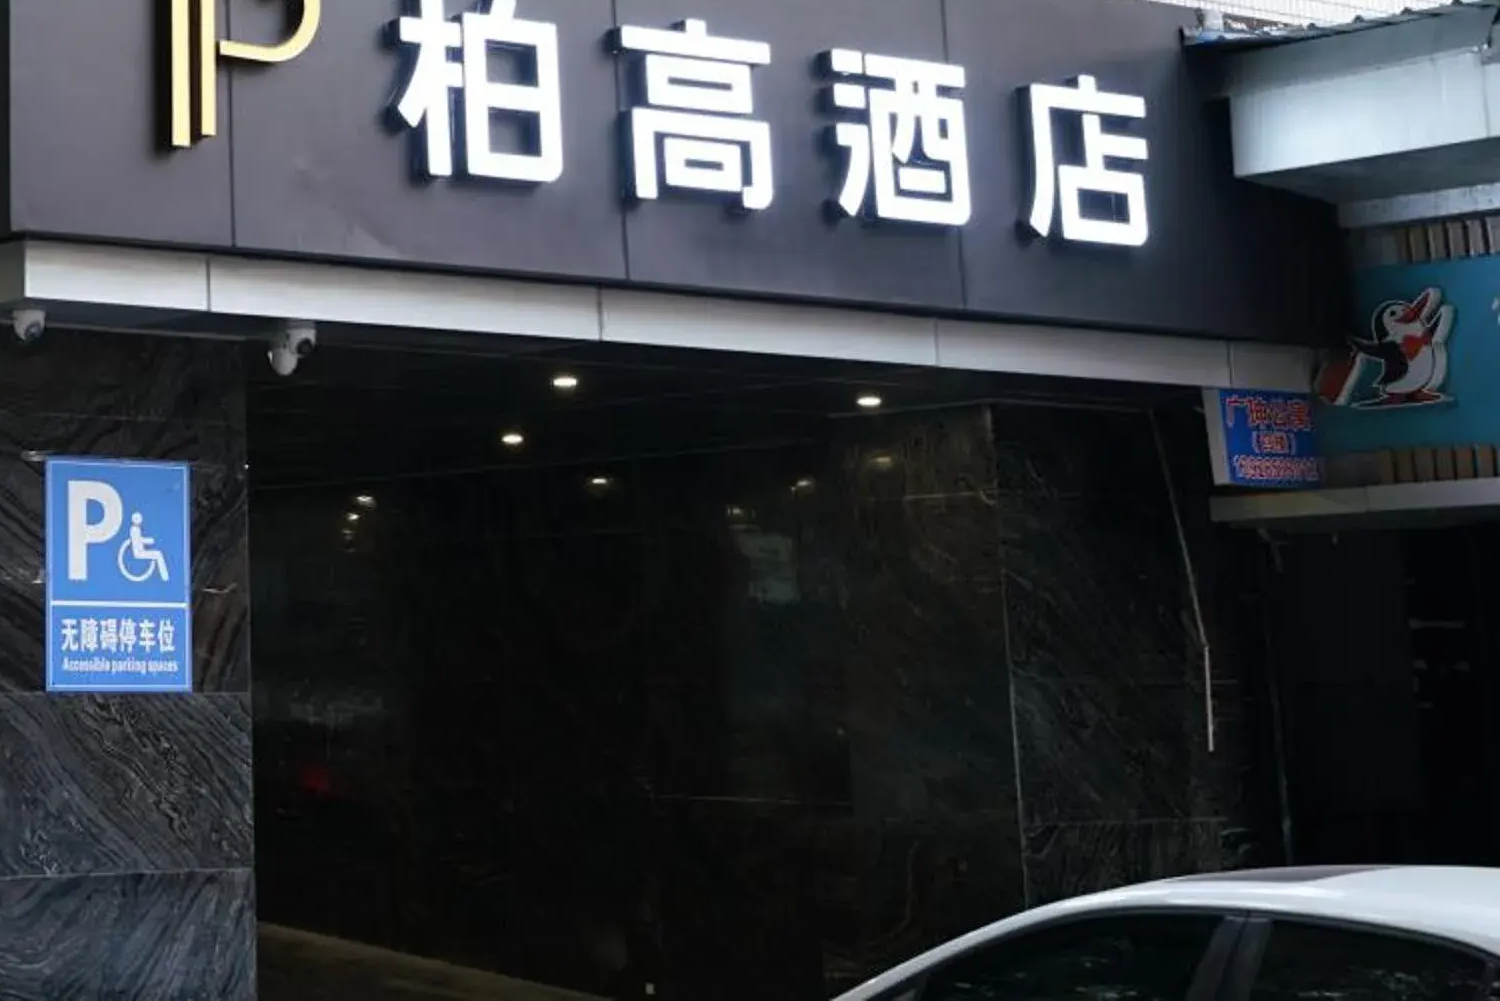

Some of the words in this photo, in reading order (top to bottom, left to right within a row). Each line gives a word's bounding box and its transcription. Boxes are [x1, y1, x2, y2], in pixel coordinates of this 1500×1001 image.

[67, 480, 124, 581] P
[61, 617, 176, 653] 无障碍停车位
[62, 656, 111, 673] Accessible
[111, 657, 147, 676] parking
